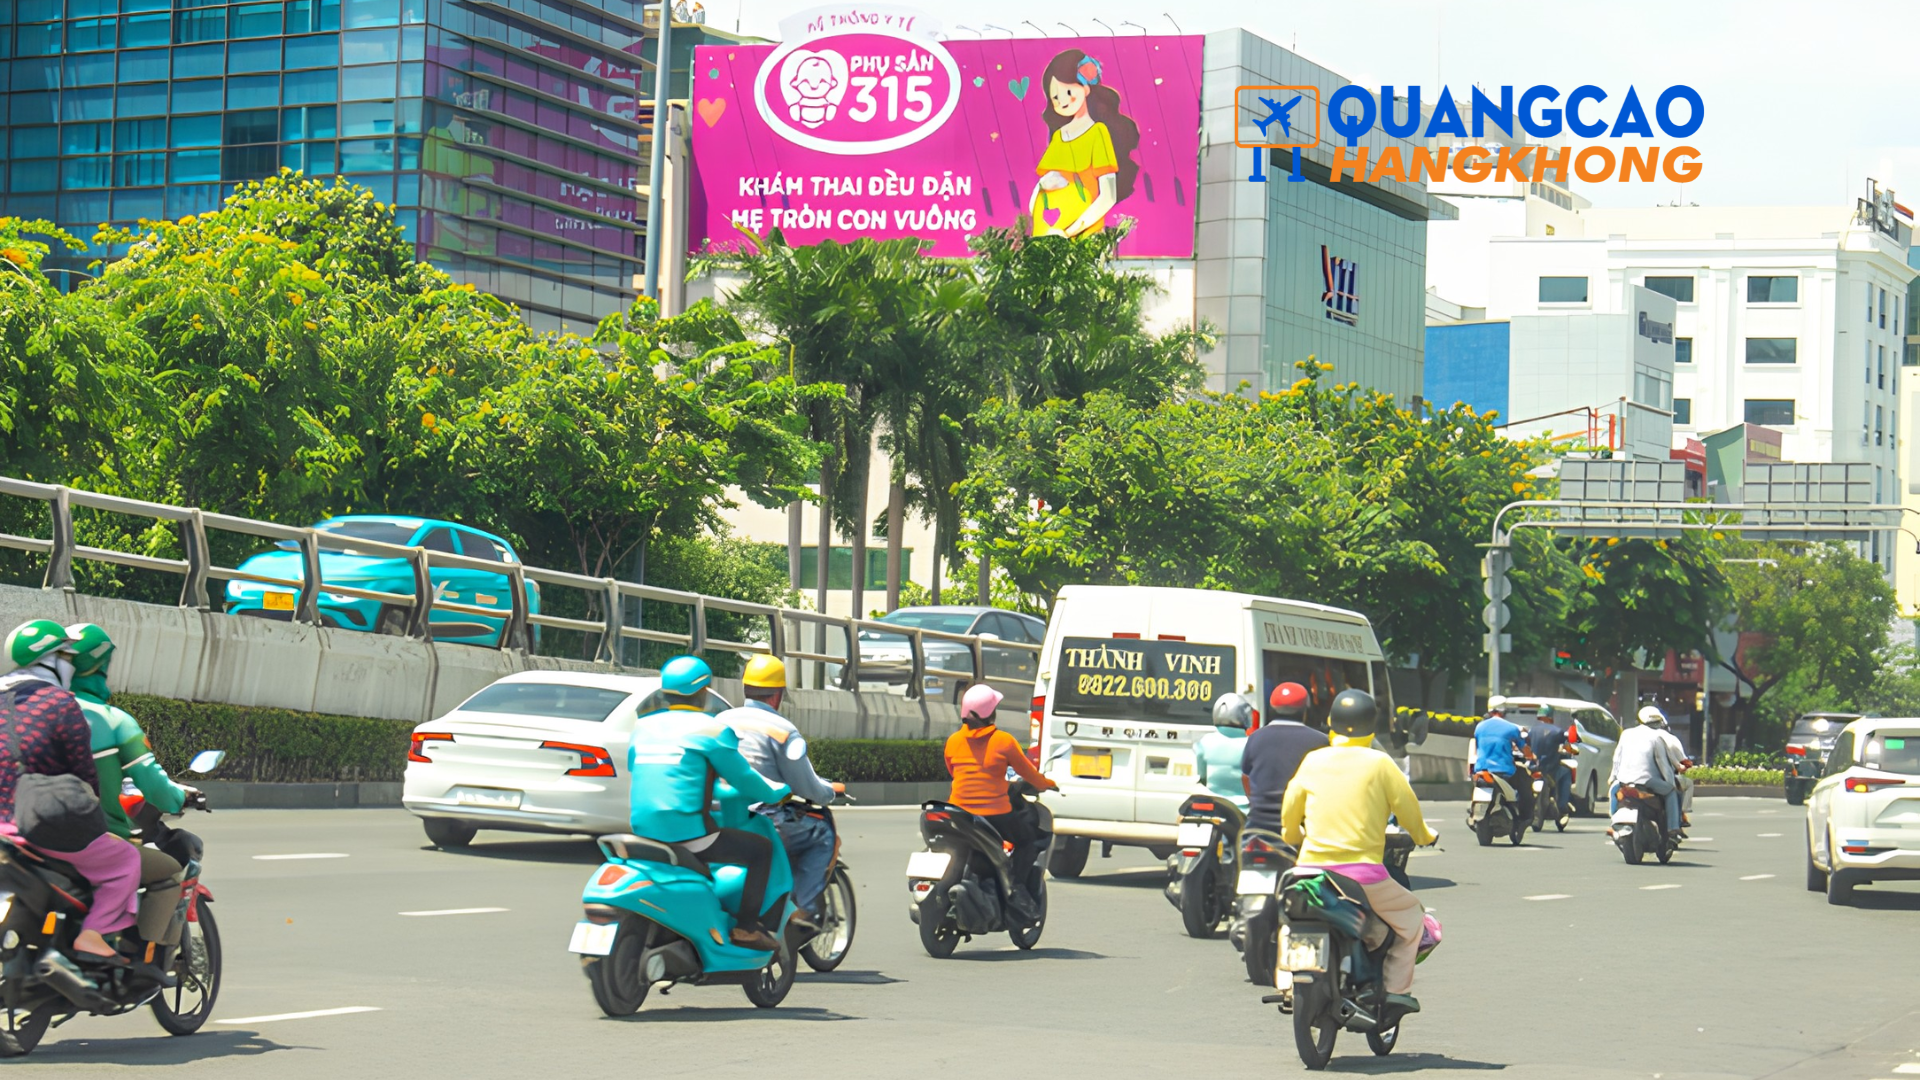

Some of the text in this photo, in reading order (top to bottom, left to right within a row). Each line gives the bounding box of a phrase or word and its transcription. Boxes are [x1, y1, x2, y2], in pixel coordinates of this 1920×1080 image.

[850, 55, 890, 77] PHỤ
[848, 75, 933, 123] 315
[739, 168, 972, 202] KHÁM THAI ĐỀU ĐẶN
[732, 203, 977, 235] MẸ TRÒN CON VUÔNG
[1066, 644, 1221, 675] THÀNH VINH
